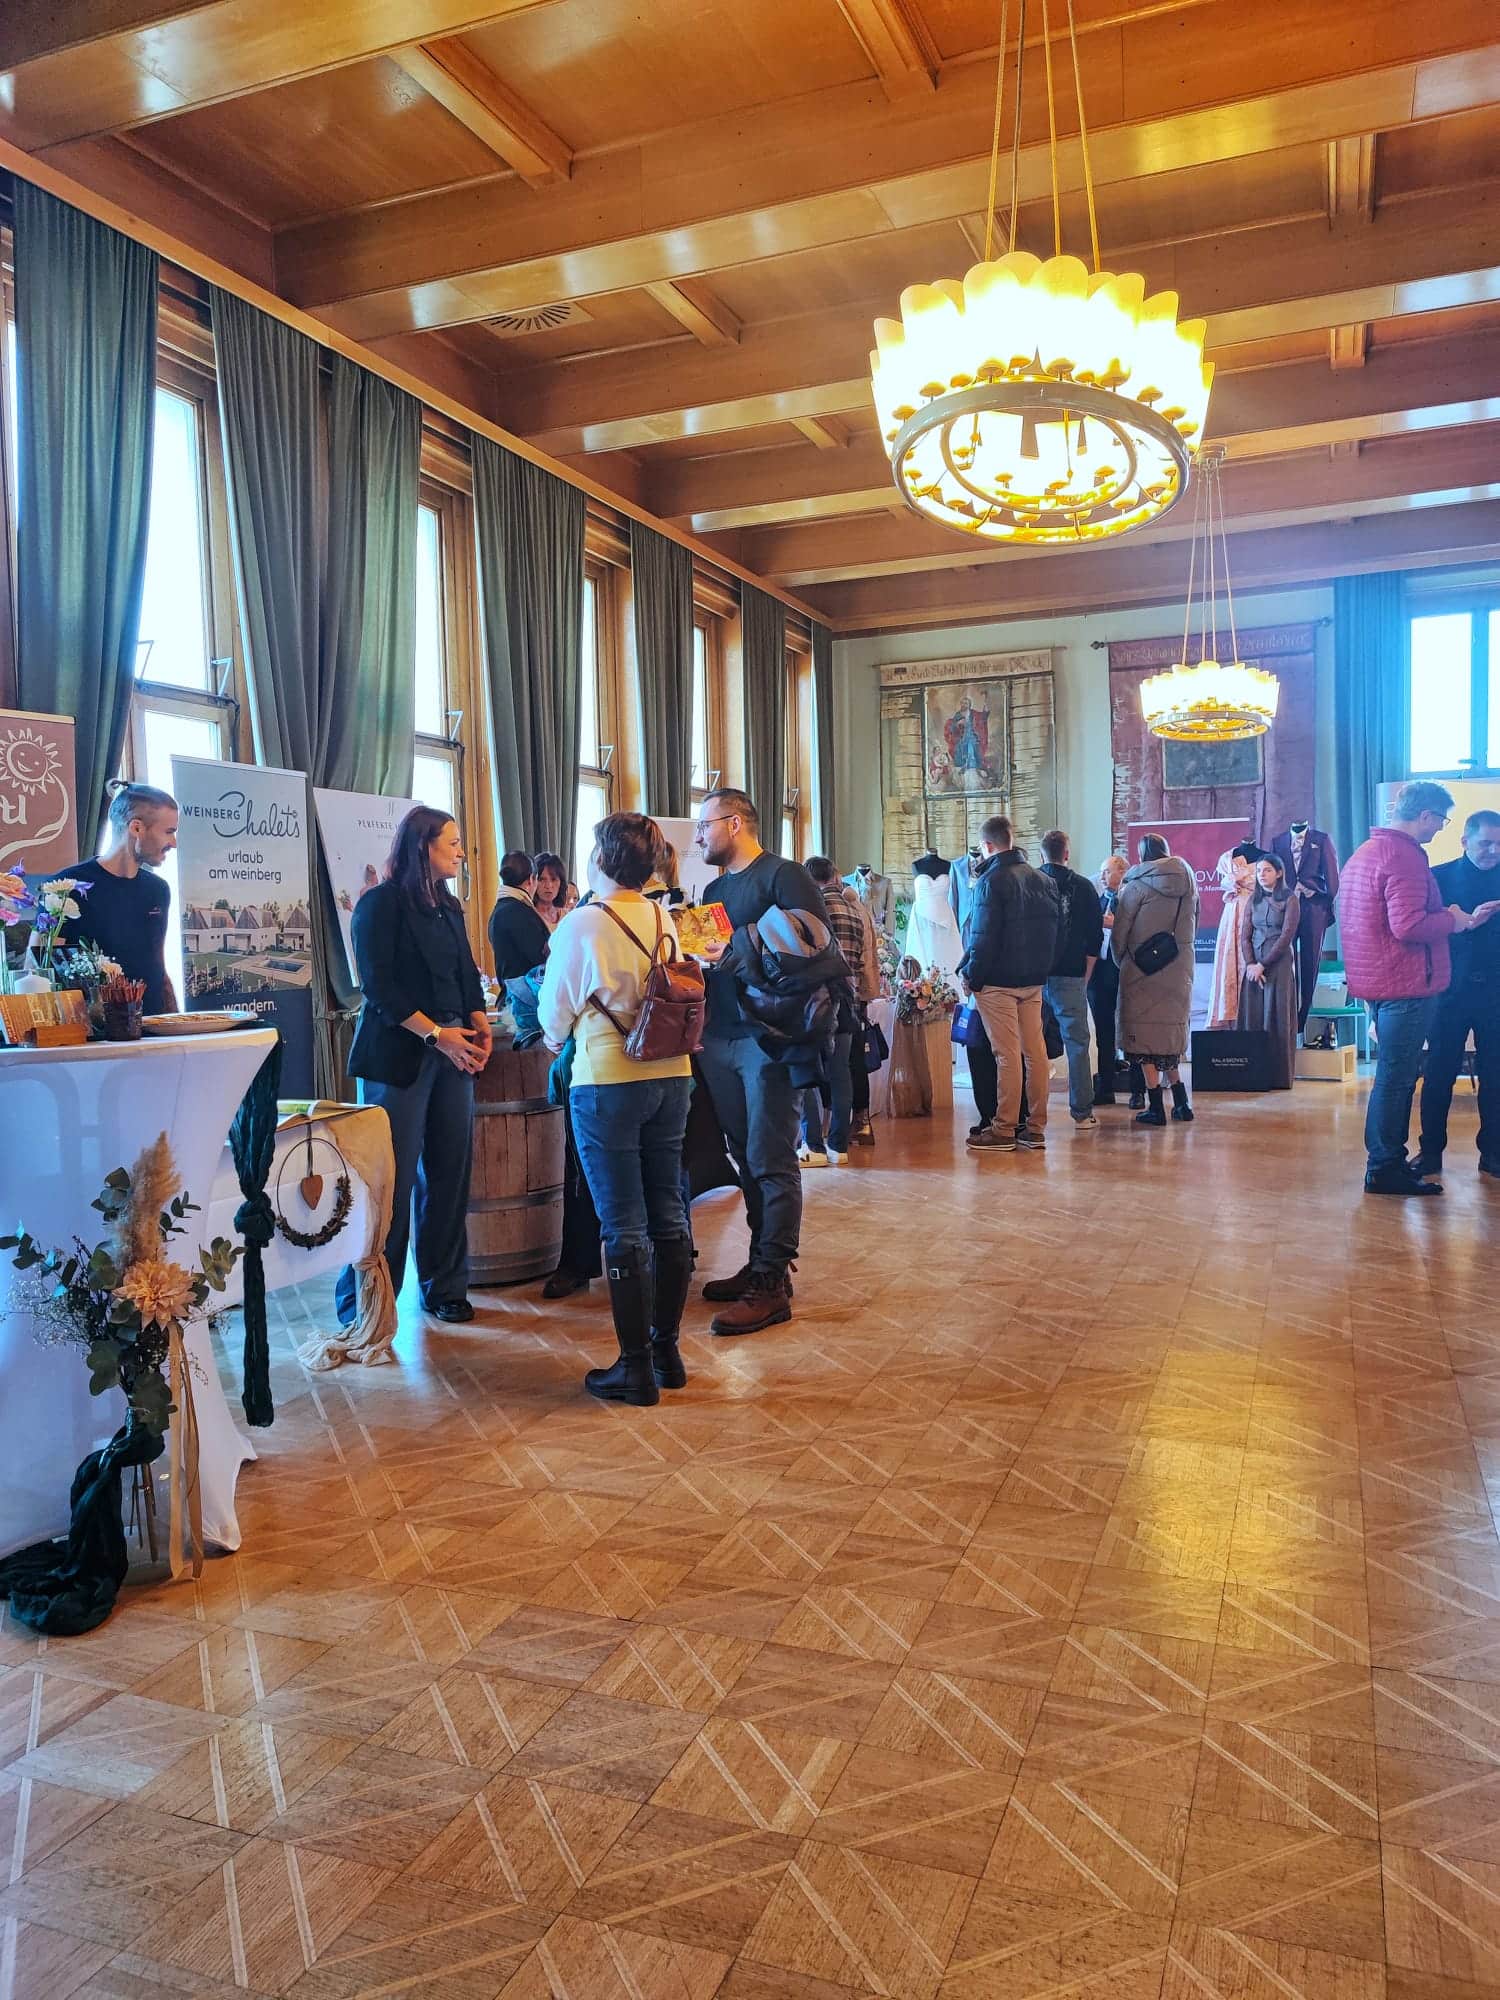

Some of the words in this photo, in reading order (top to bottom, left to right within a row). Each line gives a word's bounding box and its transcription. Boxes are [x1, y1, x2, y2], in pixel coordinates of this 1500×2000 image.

[182, 805, 241, 820] WEINBERG
[213, 790, 300, 838] Chalets
[228, 849, 264, 864] urlaub
[208, 868, 228, 880] am
[230, 866, 282, 884] weinberg
